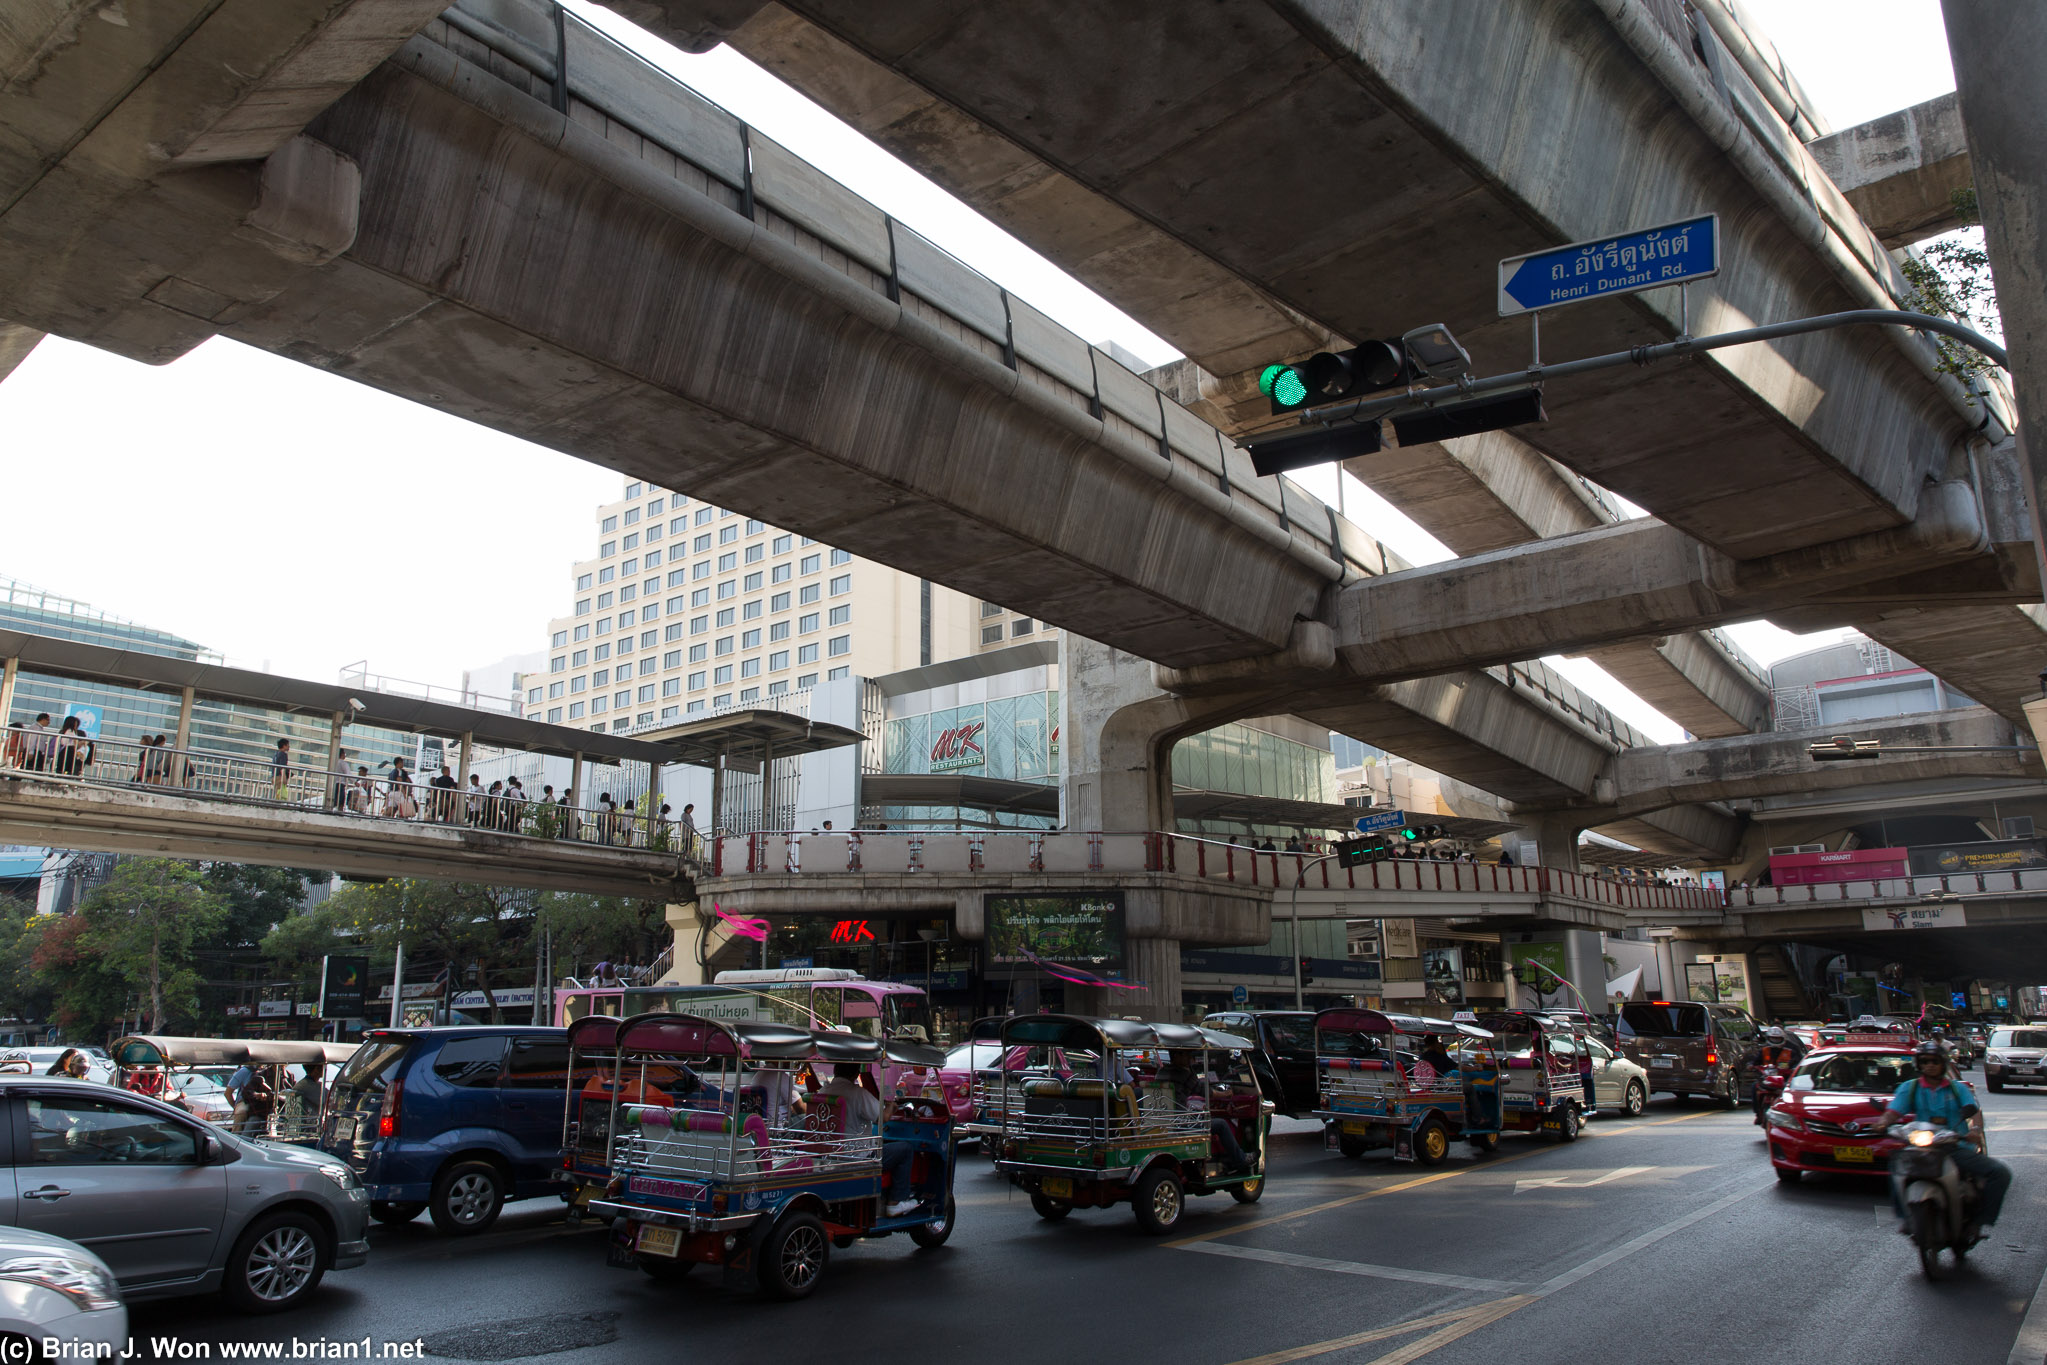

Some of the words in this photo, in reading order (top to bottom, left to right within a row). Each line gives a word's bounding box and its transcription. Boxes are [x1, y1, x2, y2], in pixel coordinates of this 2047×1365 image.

[1551, 262, 1570, 281] ถ.
[1576, 228, 1692, 275] อังรีดูนังต์
[1551, 283, 1589, 301] Henri
[1598, 270, 1652, 291] Dunant
[1662, 262, 1687, 277] Rd.
[931, 721, 983, 761] MK
[931, 757, 982, 771] RESTAURANTS
[1820, 854, 1851, 862] KARMART
[1965, 853, 2000, 861] PREMIUM
[2001, 850, 2021, 858] SUSHI
[1081, 903, 1105, 911] KBank
[1911, 909, 1941, 919] สยาม
[831, 920, 876, 944] MK
[465, 997, 485, 1005] CENTER
